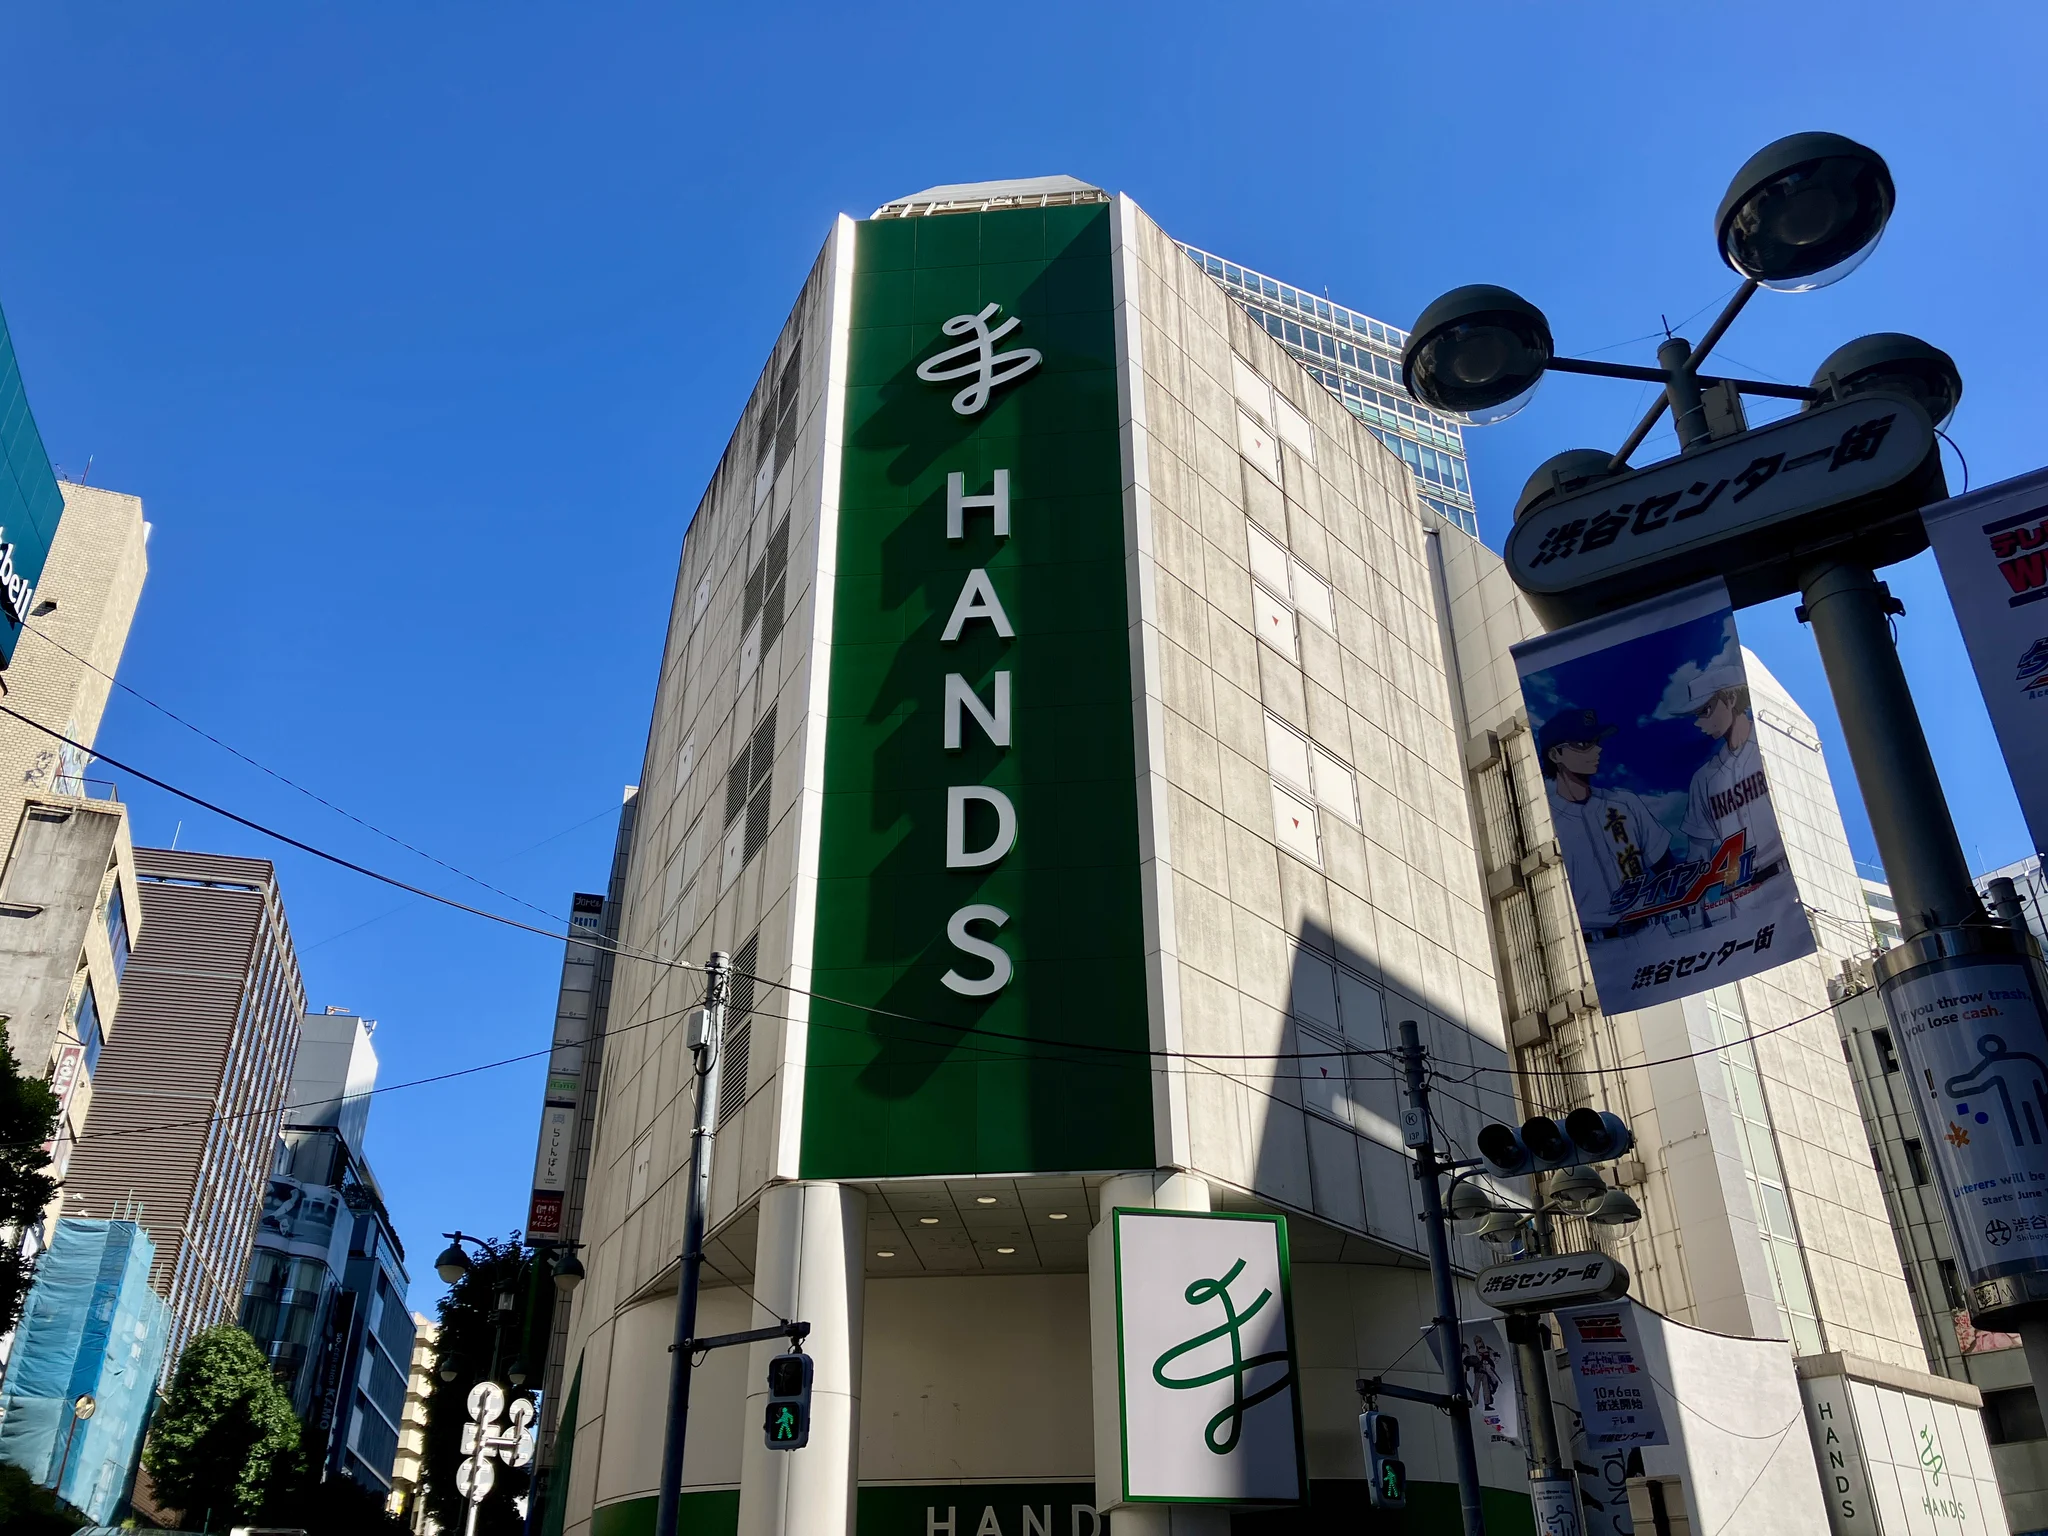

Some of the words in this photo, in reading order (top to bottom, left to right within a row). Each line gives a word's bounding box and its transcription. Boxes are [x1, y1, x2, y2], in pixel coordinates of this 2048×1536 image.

[1529, 413, 1897, 569] 渋谷センター街
[1997, 550, 2048, 594] W
[941, 468, 1018, 1002] HANDS
[1630, 923, 1776, 990] 渋谷センター街
[1909, 1001, 1934, 1020] you
[1936, 990, 1984, 1010] throw
[1988, 986, 2031, 1003] trash,
[1904, 1022, 1926, 1042] you
[1927, 1011, 1960, 1028] lose
[1962, 1005, 2005, 1021] cash.
[547, 1127, 561, 1177] らしんばん
[2000, 1172, 2026, 1185] will
[2029, 1171, 2046, 1181] be
[1982, 1192, 2014, 1206] Starts
[2018, 1189, 2043, 1200] June
[2012, 1214, 2048, 1232] 渋谷
[1482, 1261, 1604, 1293] 渋谷センター街
[1595, 1398, 1643, 1412] 放送開始
[1818, 1402, 1855, 1518] HANDS
[1921, 1496, 1966, 1520] HANDS
